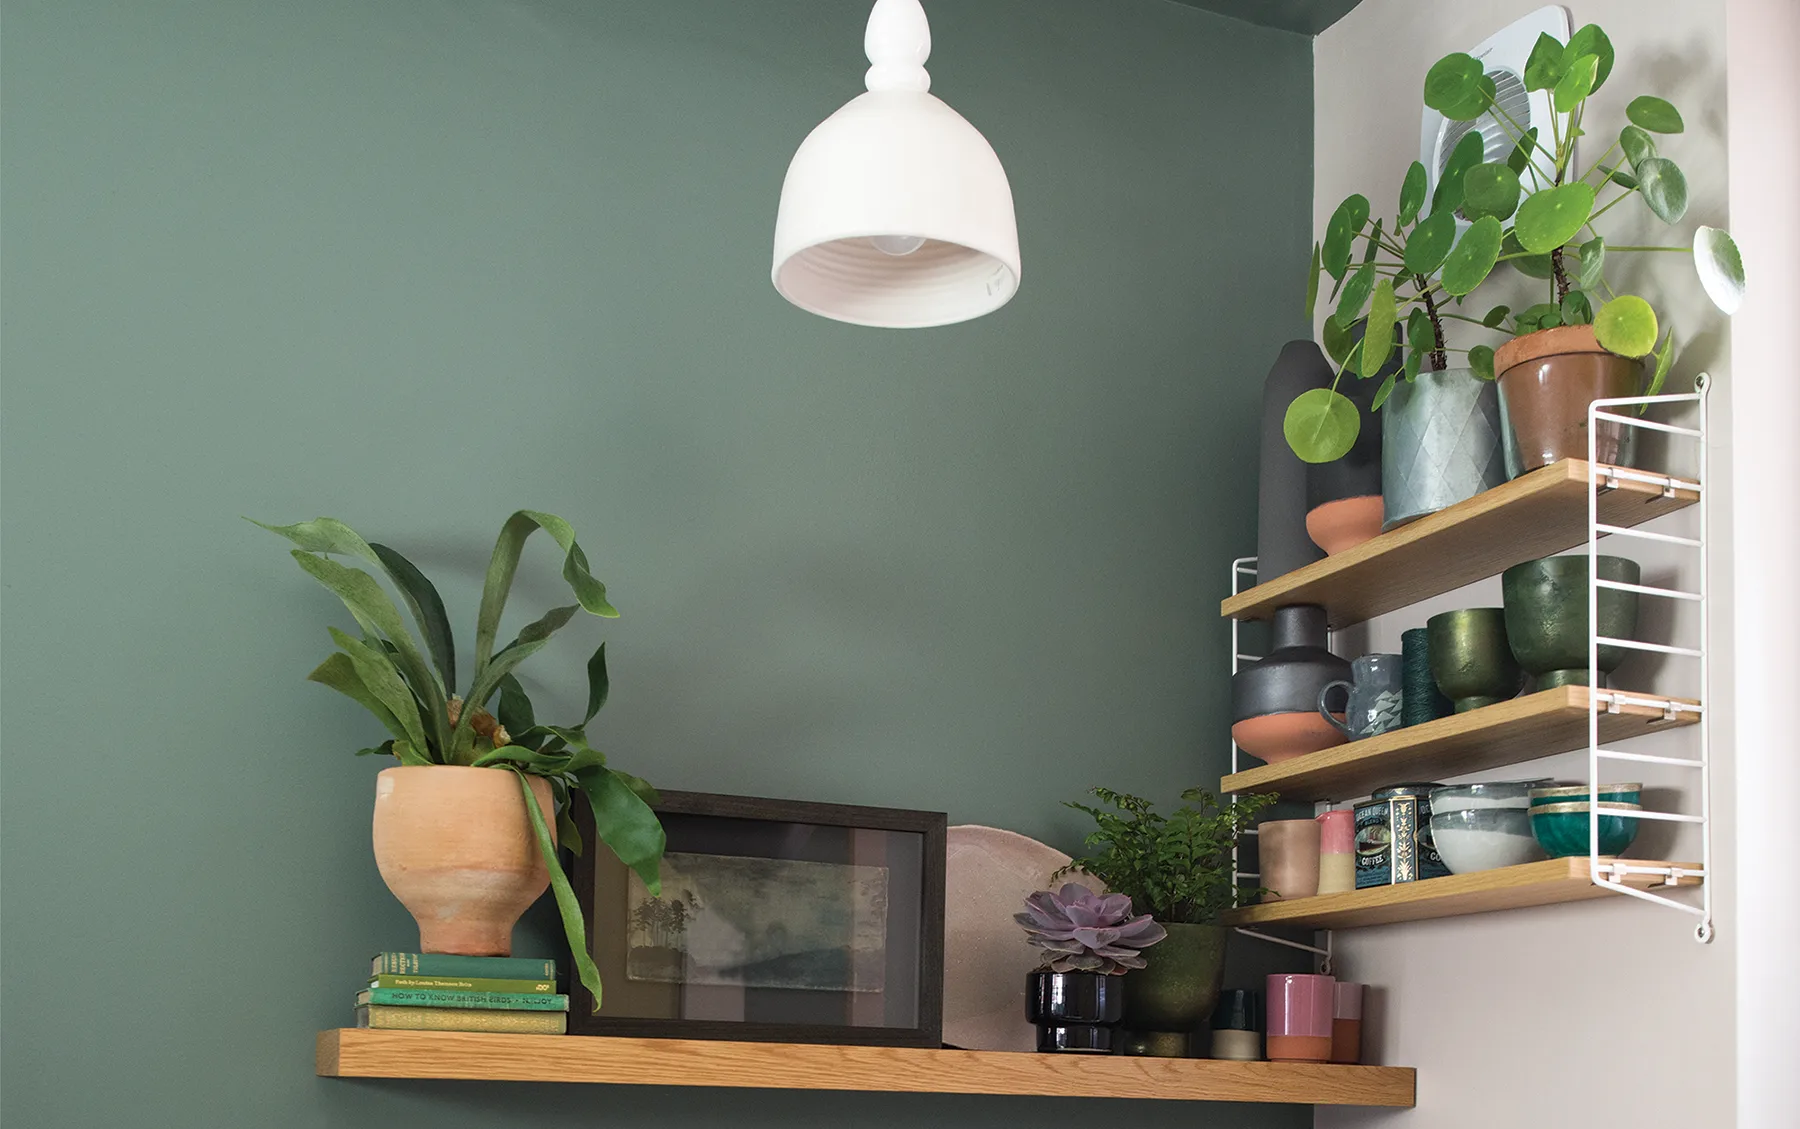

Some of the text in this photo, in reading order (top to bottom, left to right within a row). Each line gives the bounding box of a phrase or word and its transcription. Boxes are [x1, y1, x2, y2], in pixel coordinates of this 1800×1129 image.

[1361, 854, 1384, 866] COFFEE
[391, 992, 413, 1000] HOW
[415, 993, 427, 1001] TO
[429, 993, 455, 1002] KNOW
[456, 995, 488, 1003] BRITISH
[489, 996, 512, 1004] BIRDS
